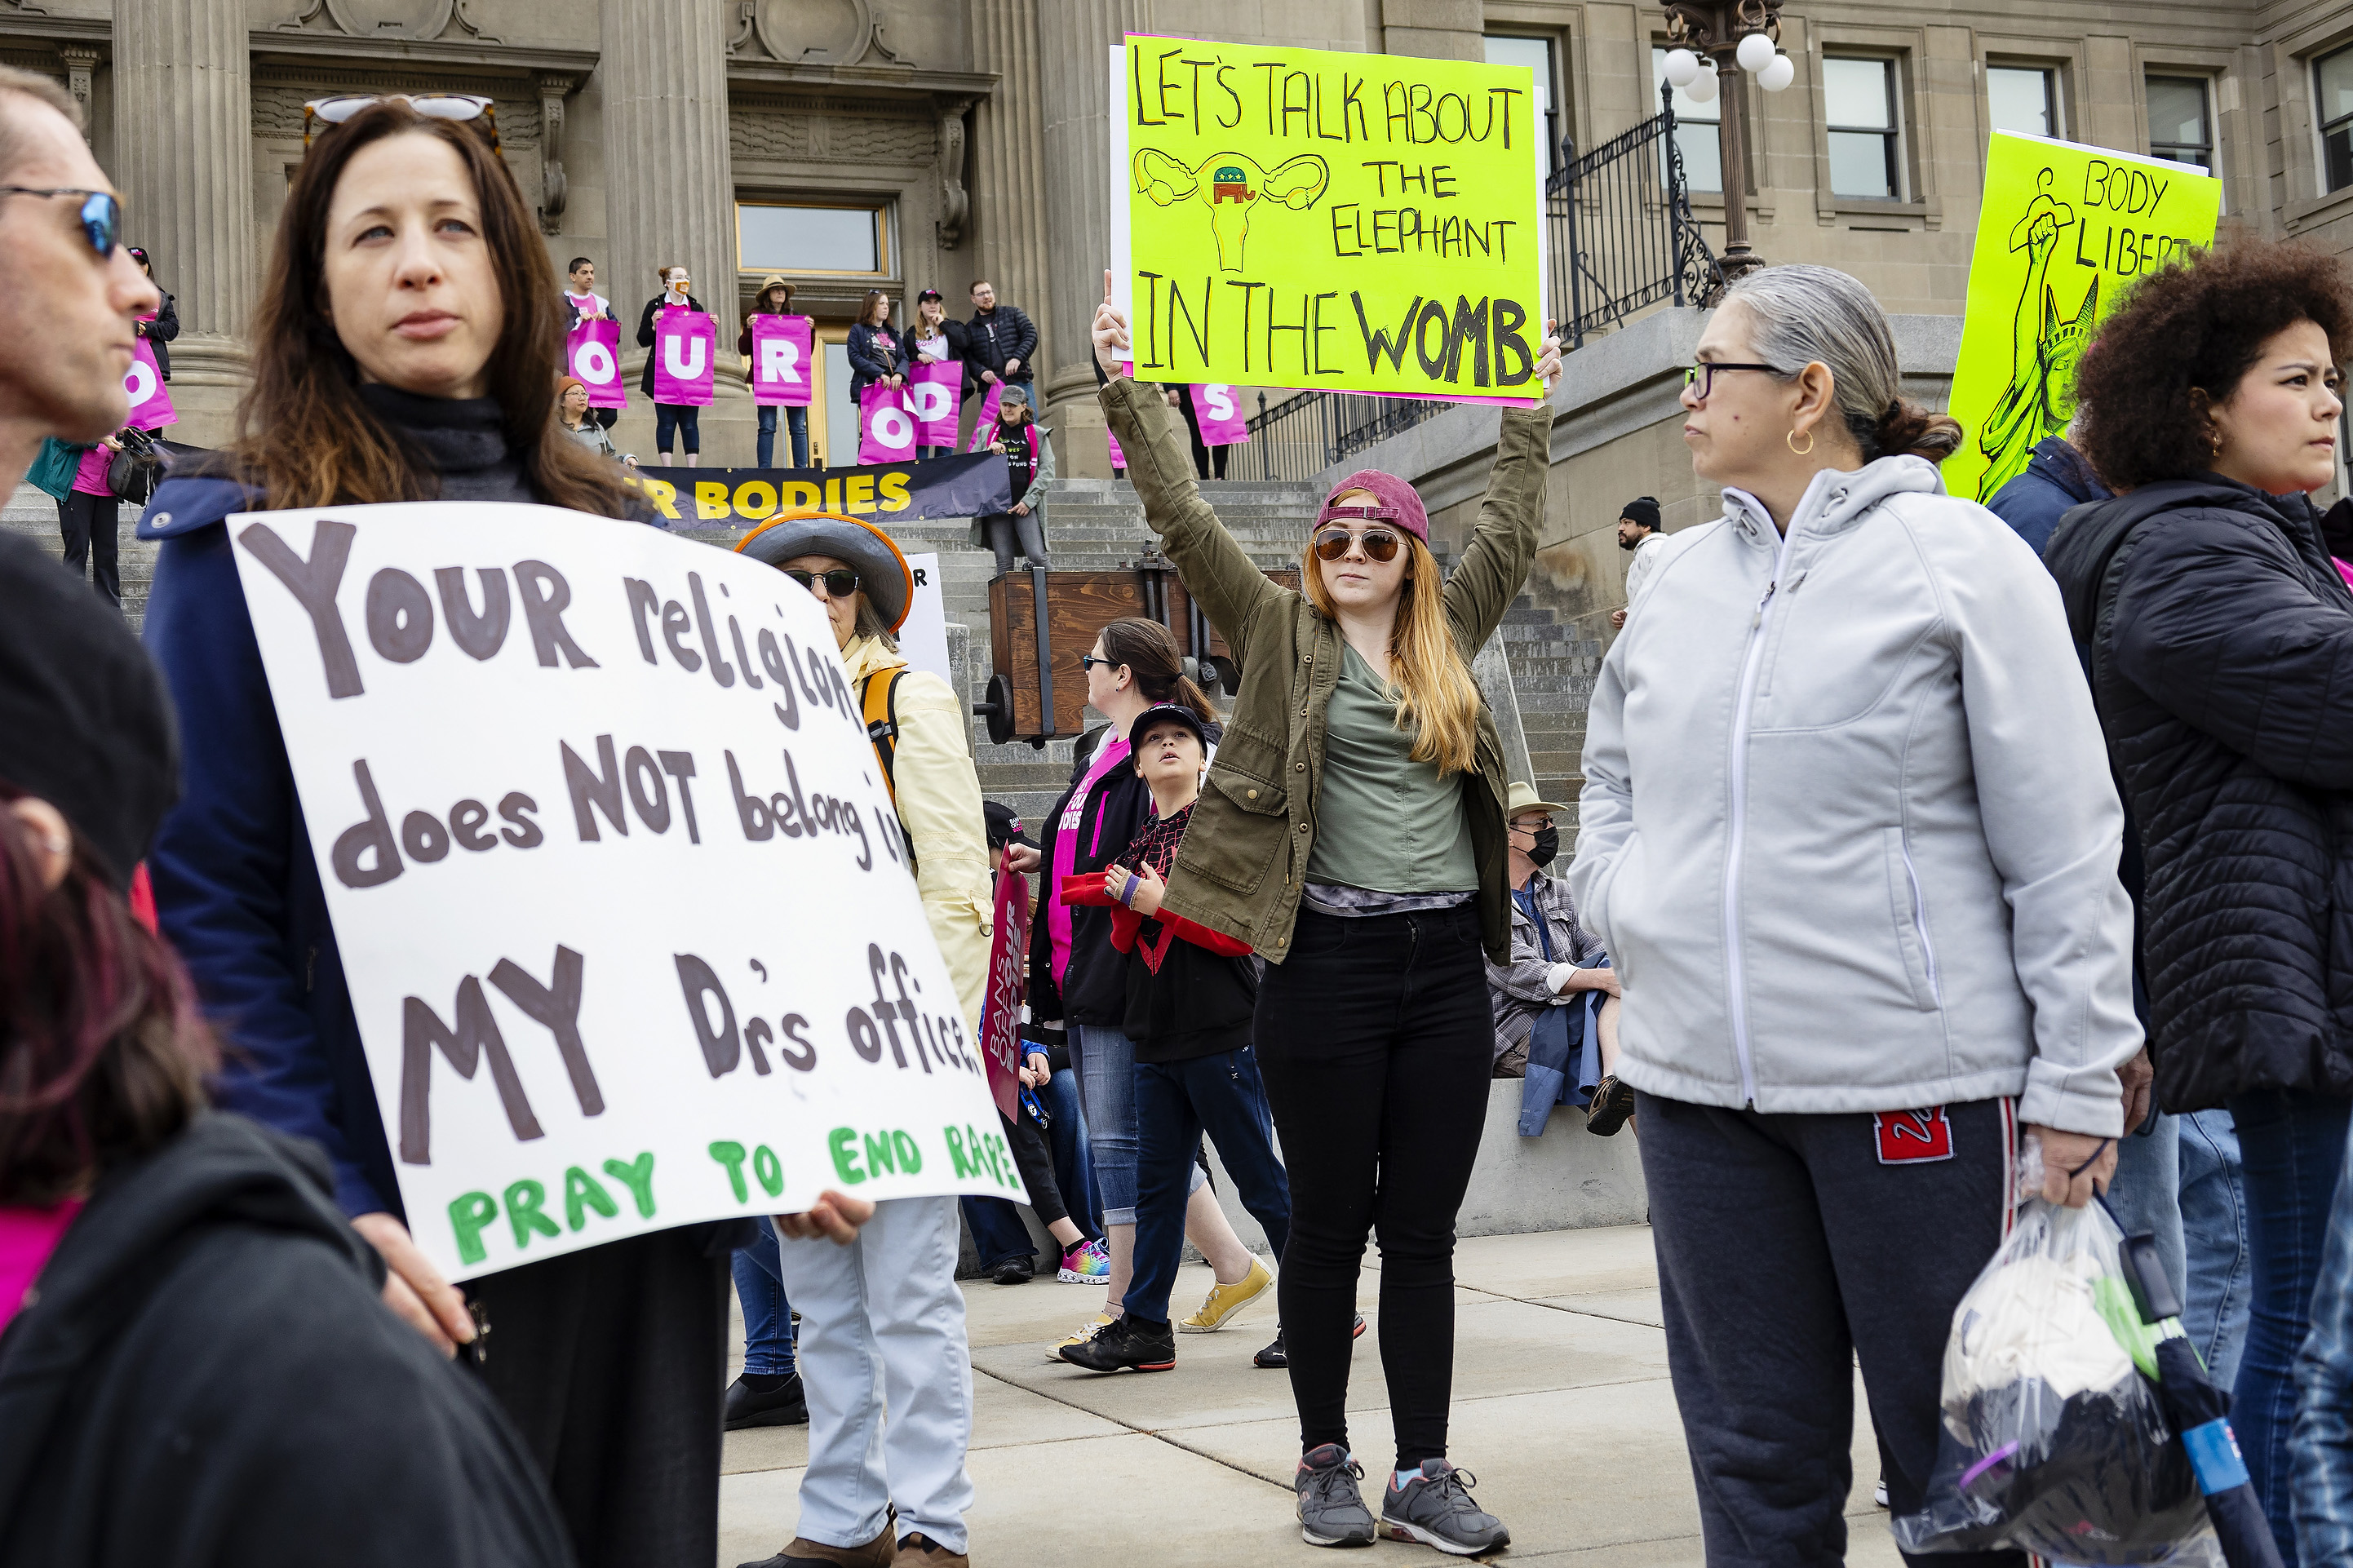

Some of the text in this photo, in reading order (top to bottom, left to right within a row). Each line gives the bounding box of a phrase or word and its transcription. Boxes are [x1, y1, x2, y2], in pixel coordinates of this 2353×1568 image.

[1133, 44, 1522, 150] LET'S TALK ABOUT
[1362, 160, 1459, 199] THE
[2083, 160, 2169, 218] BODY
[1331, 202, 1517, 265] ELEPHANT
[2076, 216, 2209, 276] LIBERT
[663, 334, 707, 380] U
[760, 339, 801, 383] R
[1138, 270, 1534, 388] IN THE WOMB
[694, 472, 912, 520] BODIES
[237, 519, 600, 699] YOUR
[331, 757, 544, 889] does
[560, 733, 701, 845] NOT
[724, 748, 872, 872] belong
[990, 953, 1005, 1059] BANS
[999, 900, 1016, 1068] OFF OUR
[1006, 923, 1022, 1075] BODIES
[399, 943, 606, 1166] MY
[446, 1123, 1020, 1265] PRAY TO END RAPE
